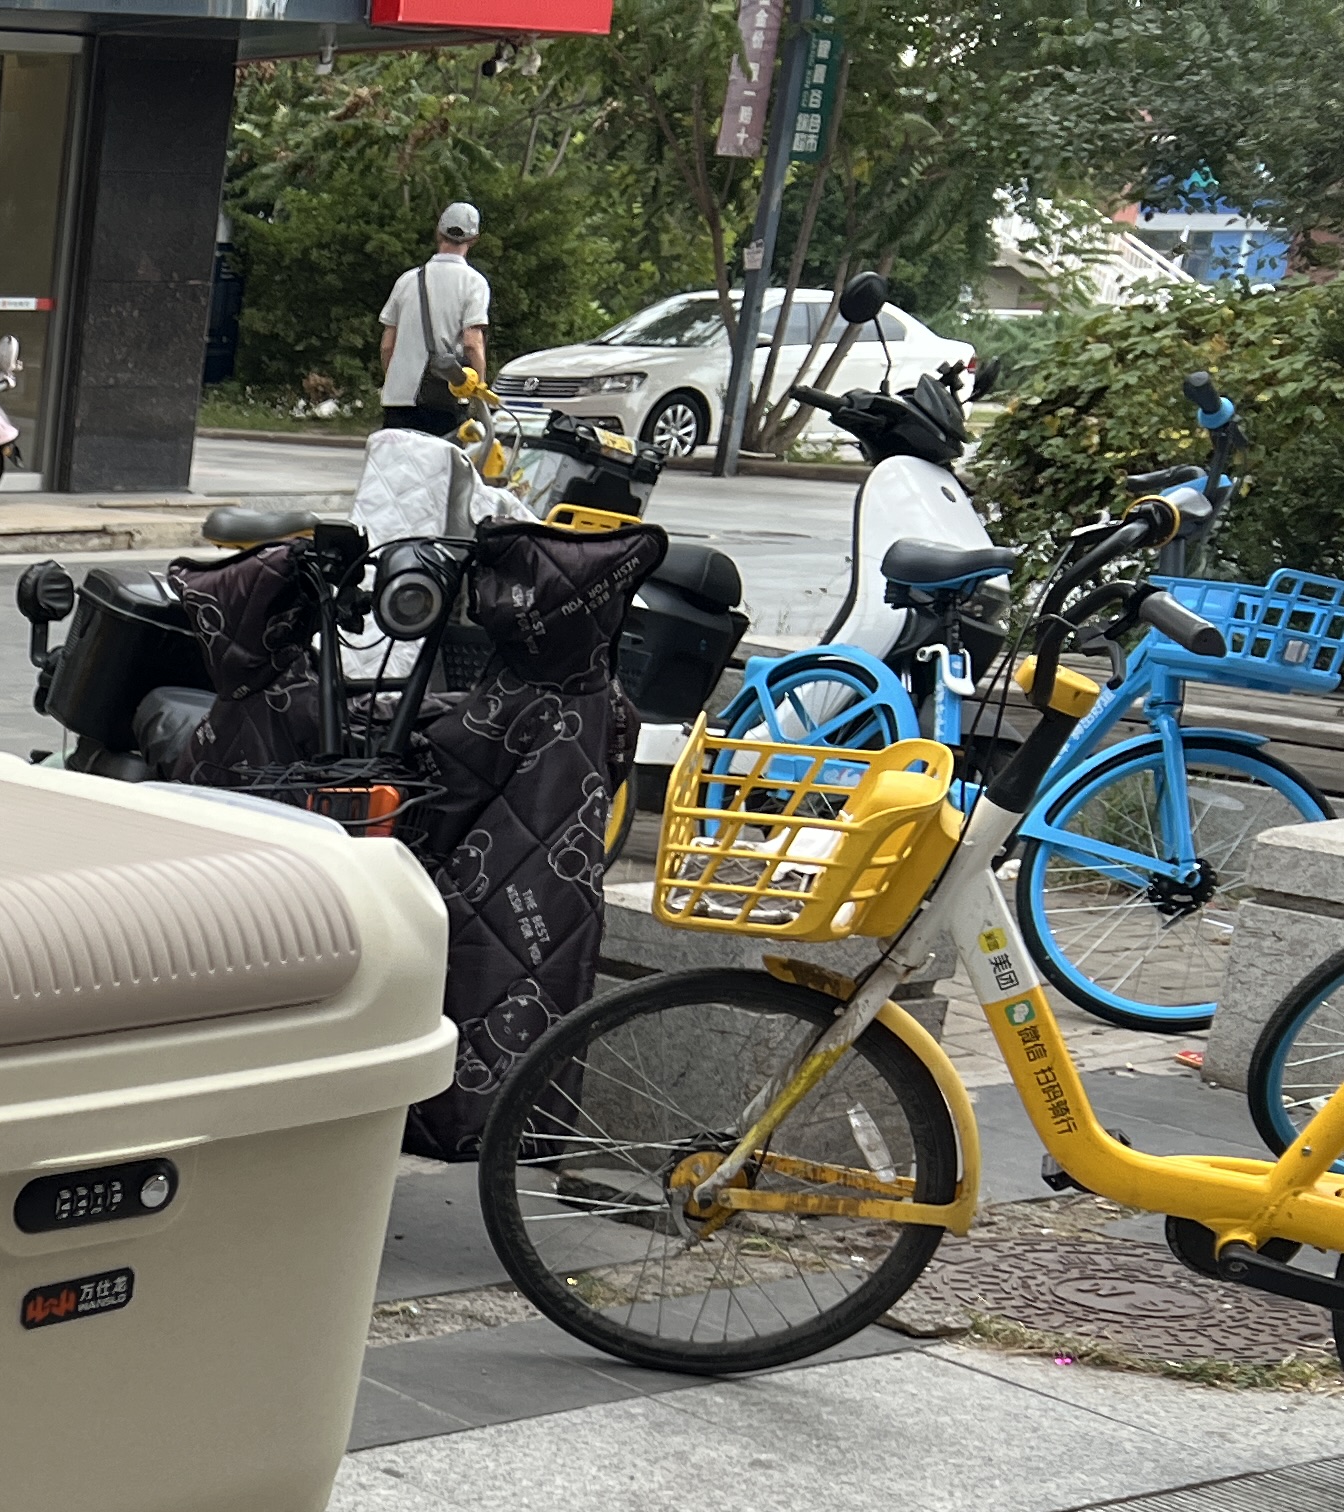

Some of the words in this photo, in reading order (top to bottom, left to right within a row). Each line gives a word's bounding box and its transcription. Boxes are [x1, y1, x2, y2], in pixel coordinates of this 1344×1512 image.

[613, 556, 641, 581] WISH
[562, 597, 585, 616] YOU
[531, 915, 551, 943] BEST
[988, 953, 1019, 991] 美团
[1017, 1025, 1048, 1062] 微信
[1033, 1065, 1079, 1135] 扫码骑行
[79, 1275, 129, 1302] 万仕龙
